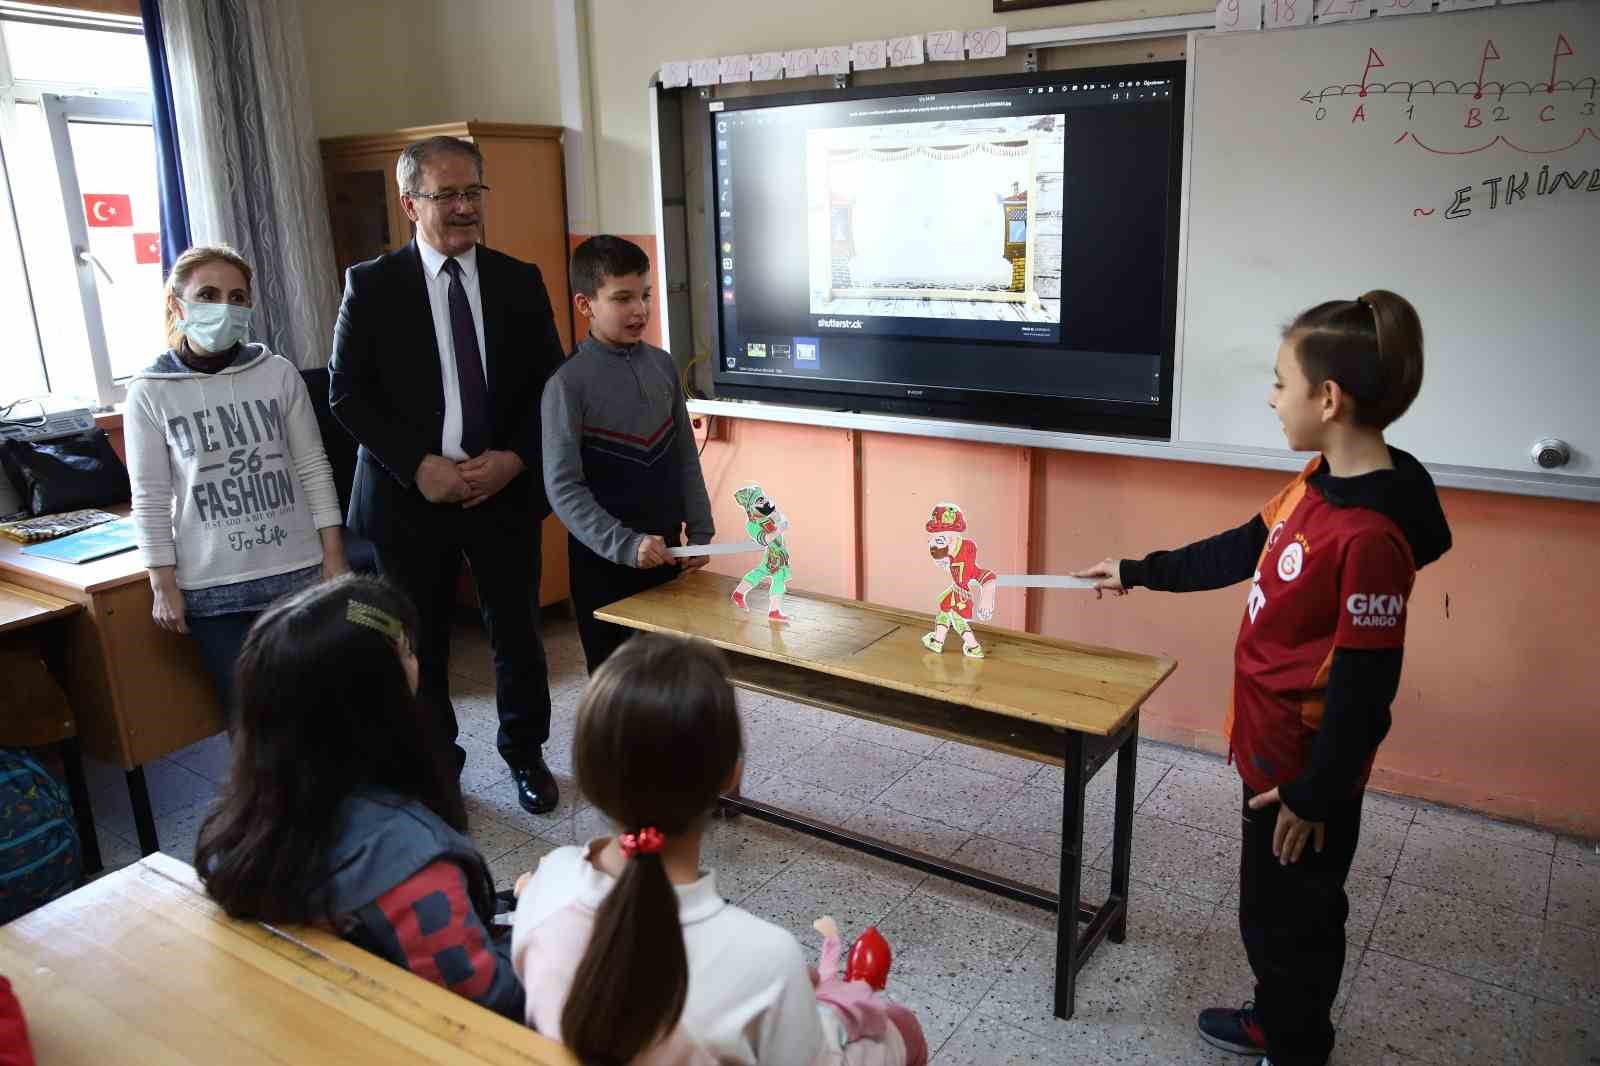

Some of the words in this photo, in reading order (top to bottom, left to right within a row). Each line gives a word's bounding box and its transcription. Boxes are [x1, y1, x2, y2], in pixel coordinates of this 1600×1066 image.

[1224, 0, 1239, 26] 9
[1272, 0, 1296, 23] 18
[972, 29, 1000, 54] 80
[1316, 107, 1327, 120] 0
[1352, 104, 1365, 123] A
[1406, 104, 1414, 120] 1
[1464, 107, 1482, 128] B
[1492, 106, 1510, 121] 2
[1540, 105, 1555, 121] C
[1580, 102, 1595, 116] 3
[167, 399, 284, 458] DENIM
[192, 469, 295, 522] FASHION
[228, 530, 254, 551] To
[255, 524, 288, 546] Life
[1346, 593, 1403, 615] GKN
[1352, 615, 1397, 627] KARGO
